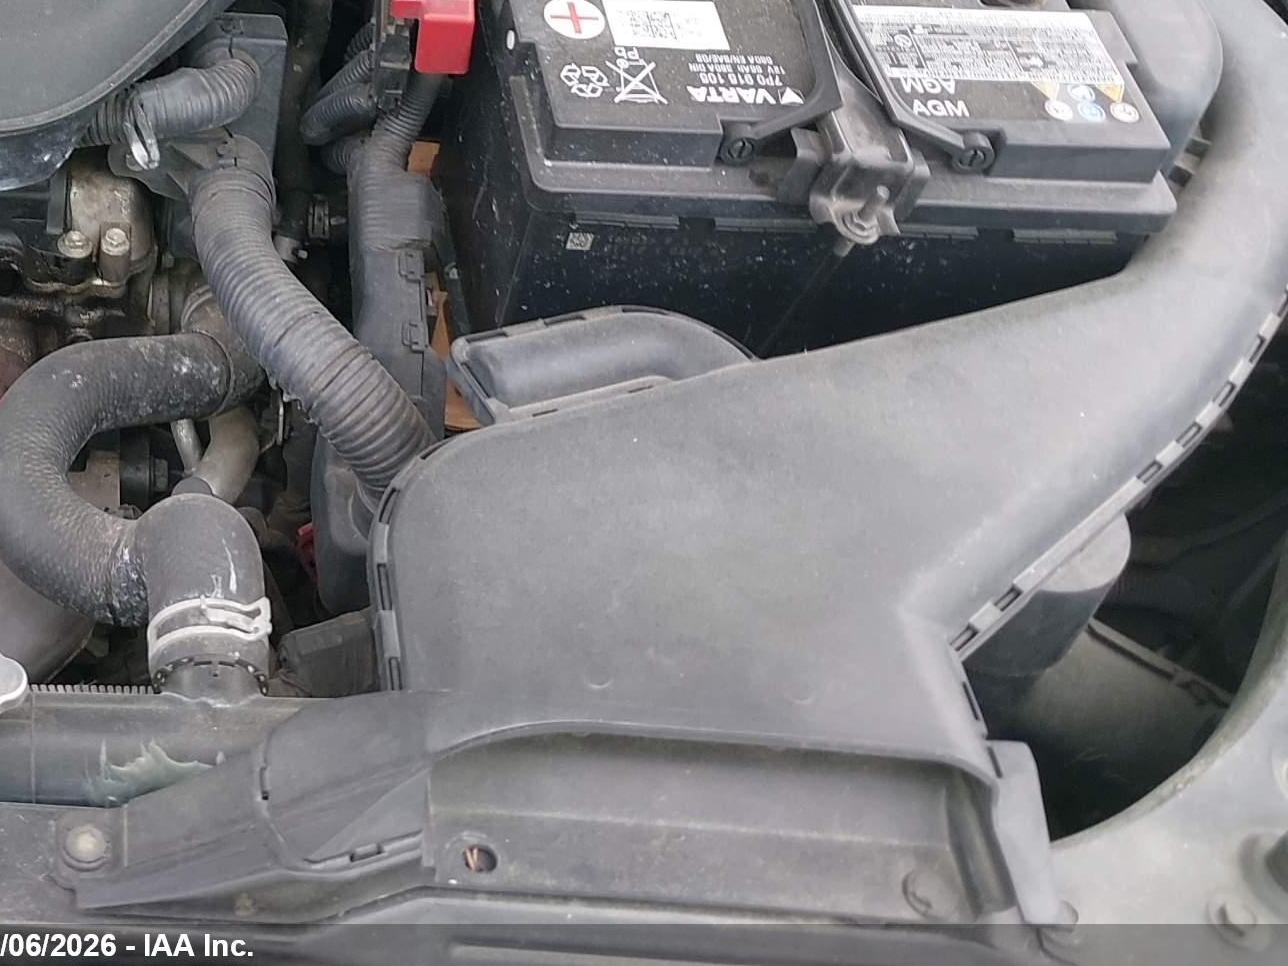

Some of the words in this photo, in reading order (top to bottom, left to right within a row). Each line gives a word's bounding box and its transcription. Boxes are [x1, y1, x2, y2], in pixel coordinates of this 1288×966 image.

[614, 46, 640, 60] Pb
[686, 85, 777, 105] VARTA
[900, 76, 956, 95] AGM
[913, 99, 970, 118] AGM
